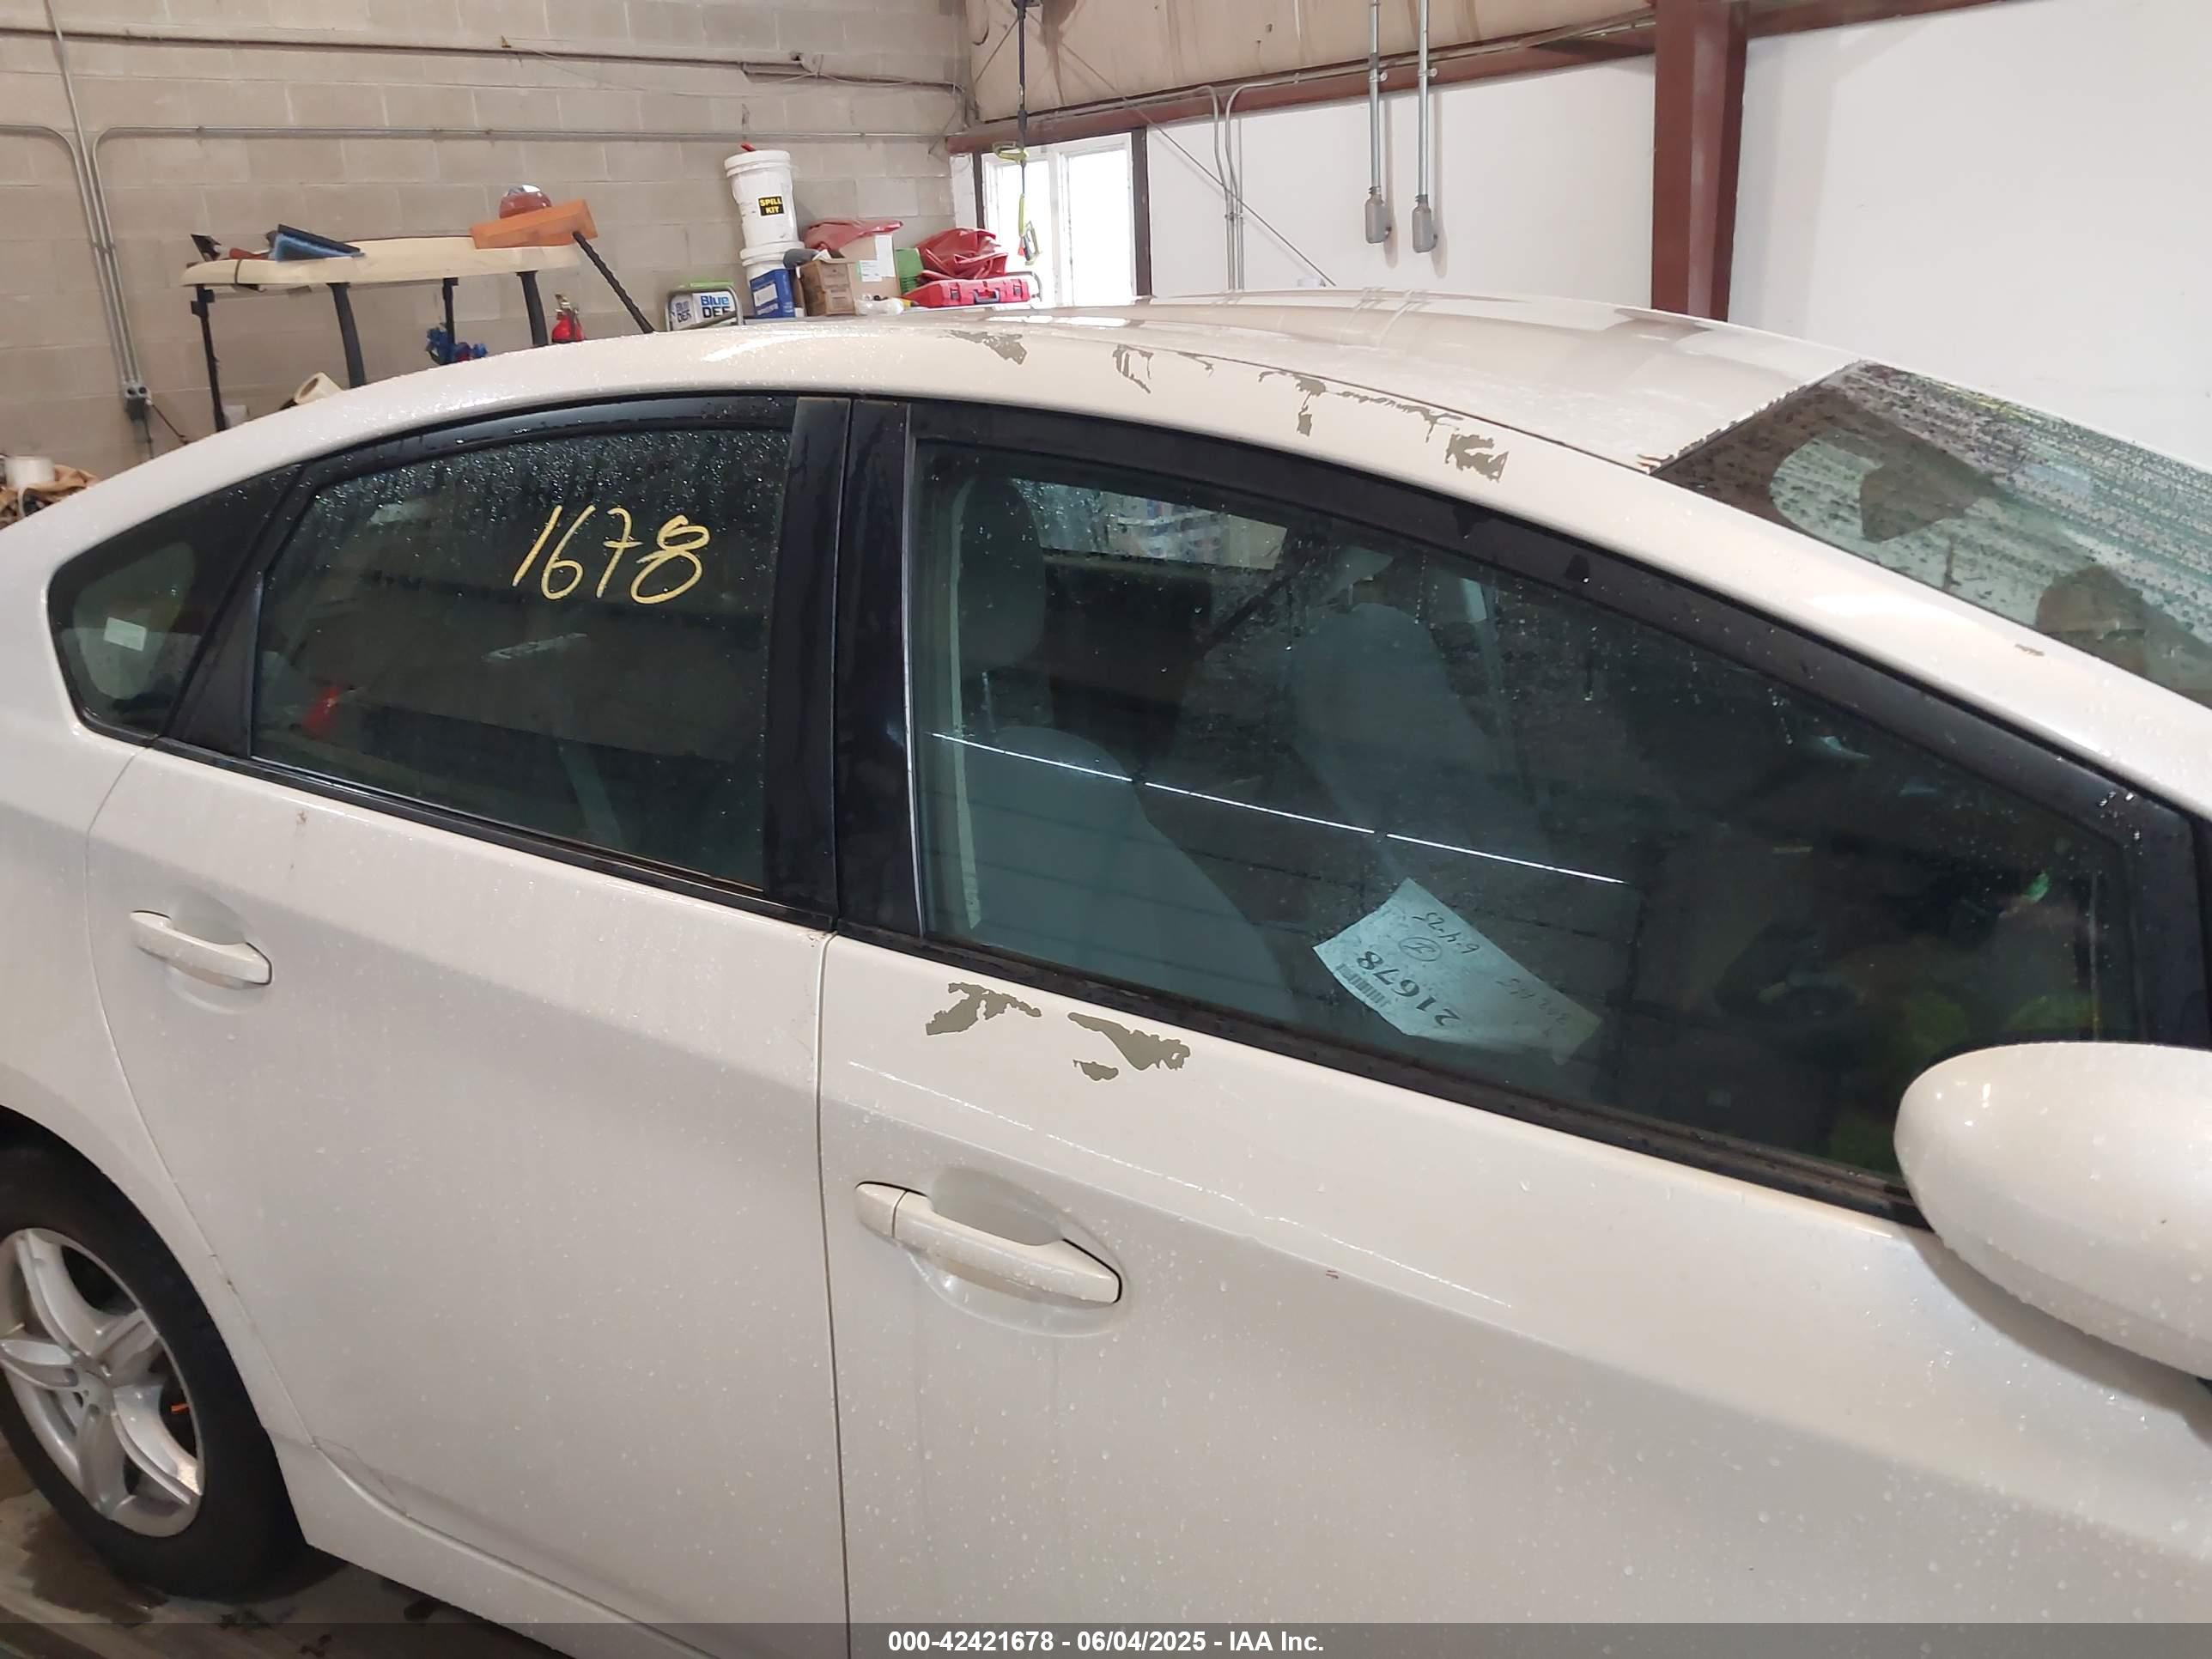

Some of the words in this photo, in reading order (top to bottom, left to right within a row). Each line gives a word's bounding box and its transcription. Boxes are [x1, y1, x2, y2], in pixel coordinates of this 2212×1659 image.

[759, 198, 782, 207] SPILL
[700, 295, 730, 306] Blue
[702, 306, 731, 319] DEF
[511, 504, 712, 605] 1678
[1357, 951, 1460, 1026] 21678
